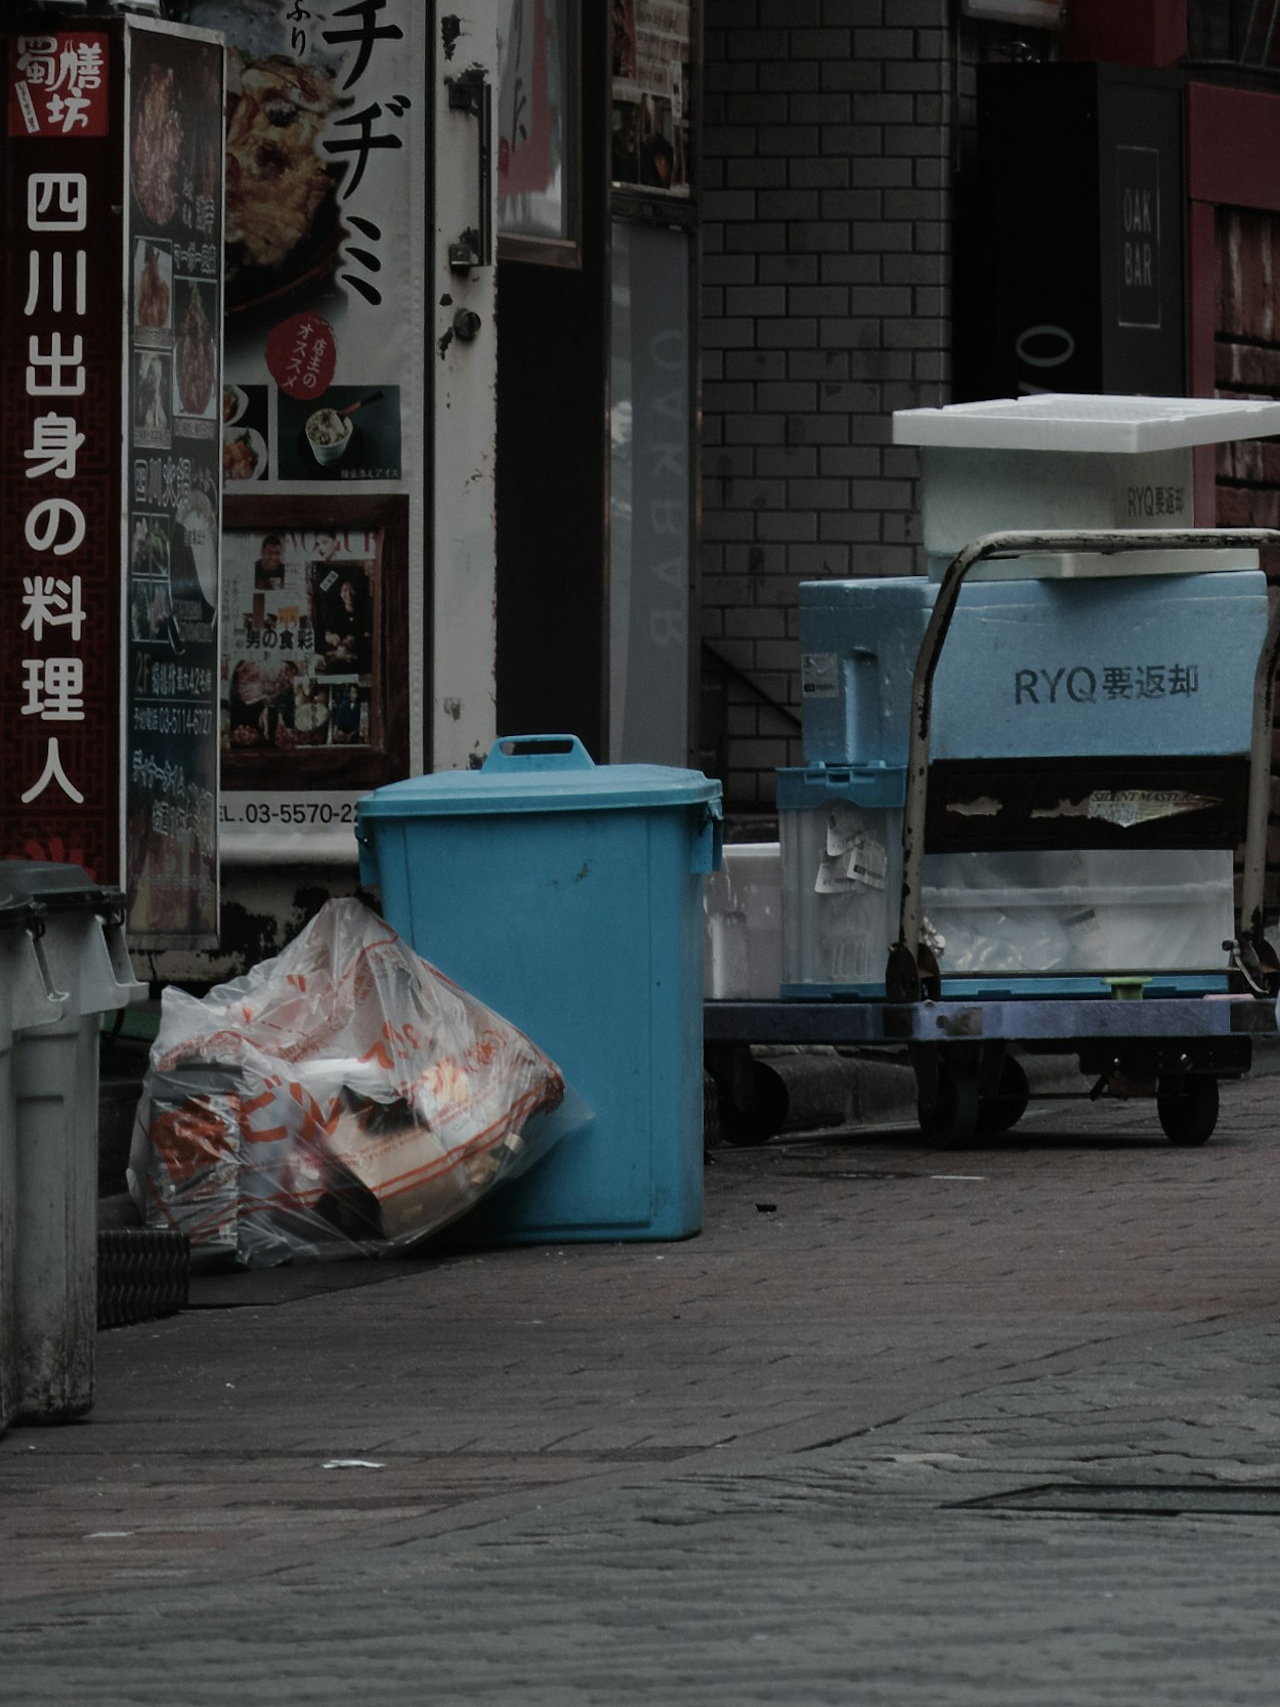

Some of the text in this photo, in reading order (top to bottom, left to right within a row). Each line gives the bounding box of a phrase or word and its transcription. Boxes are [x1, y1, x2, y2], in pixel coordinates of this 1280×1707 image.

[1123, 187, 1152, 234] OAK
[1123, 240, 1153, 289] BAR
[283, 323, 312, 390] オススメ
[21, 169, 89, 809] 四川出身の料理人
[245, 628, 315, 652] 男の食彩
